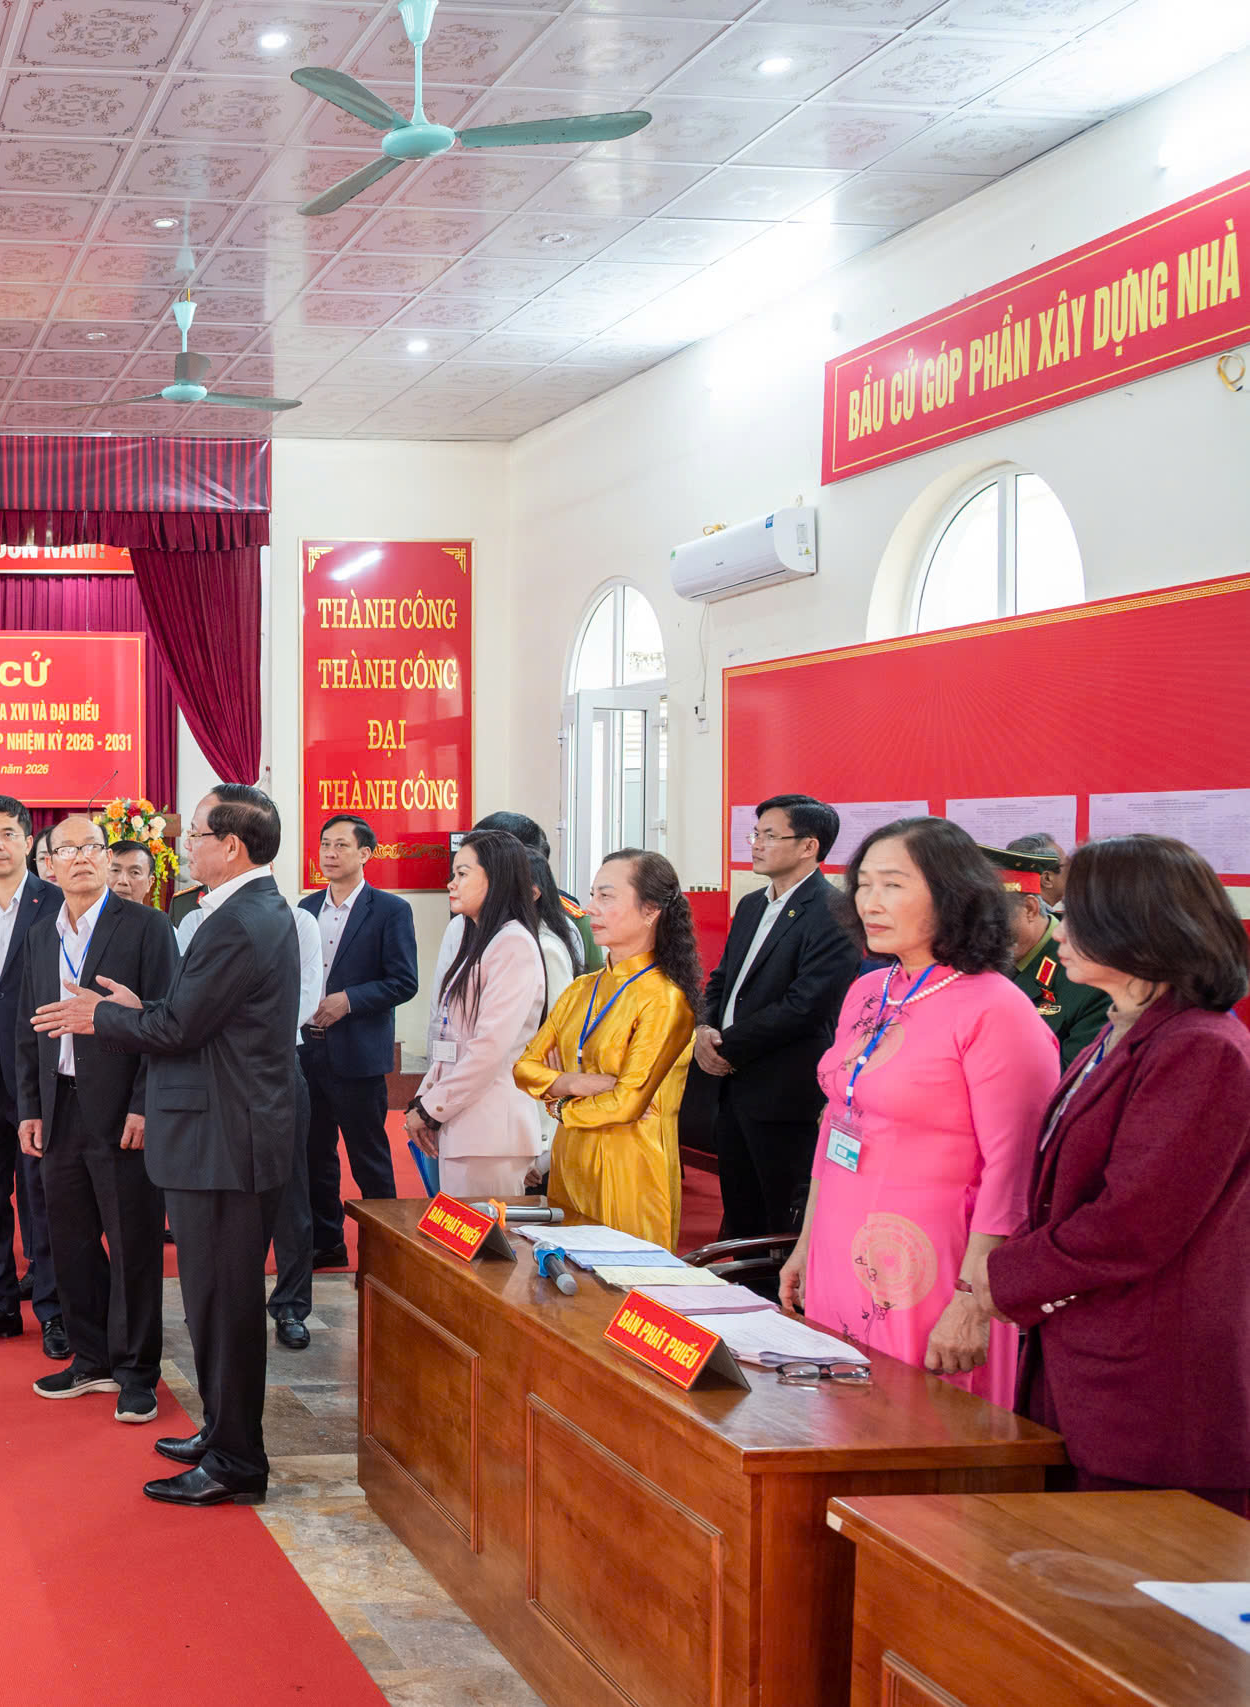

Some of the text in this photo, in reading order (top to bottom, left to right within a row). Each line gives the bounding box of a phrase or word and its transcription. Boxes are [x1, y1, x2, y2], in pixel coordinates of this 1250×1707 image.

[848, 218, 1240, 441] BẦU CỬ GÓP PHẦN XÂY DỰNG NHÀ
[318, 589, 457, 629] THÀNH CÔNG
[318, 649, 458, 689] THÀNH CÔNG
[10, 703, 30, 721] XVI
[32, 700, 48, 721] VÀ
[50, 702, 70, 725] ĐẠI
[72, 697, 99, 722] BIỂU
[6, 729, 45, 754] NHIỆM
[47, 729, 63, 751] KỲ
[66, 734, 94, 751] 2026
[105, 734, 132, 751] 2031
[367, 719, 406, 758] ĐẠI
[0, 764, 23, 775] năm
[25, 764, 49, 775] 2026
[319, 769, 458, 810] THÀNH CÔNG
[428, 1205, 481, 1246] BÀN PHÁT PHIẾU
[617, 1309, 701, 1369] BÀN PHÁT PHIẾU
